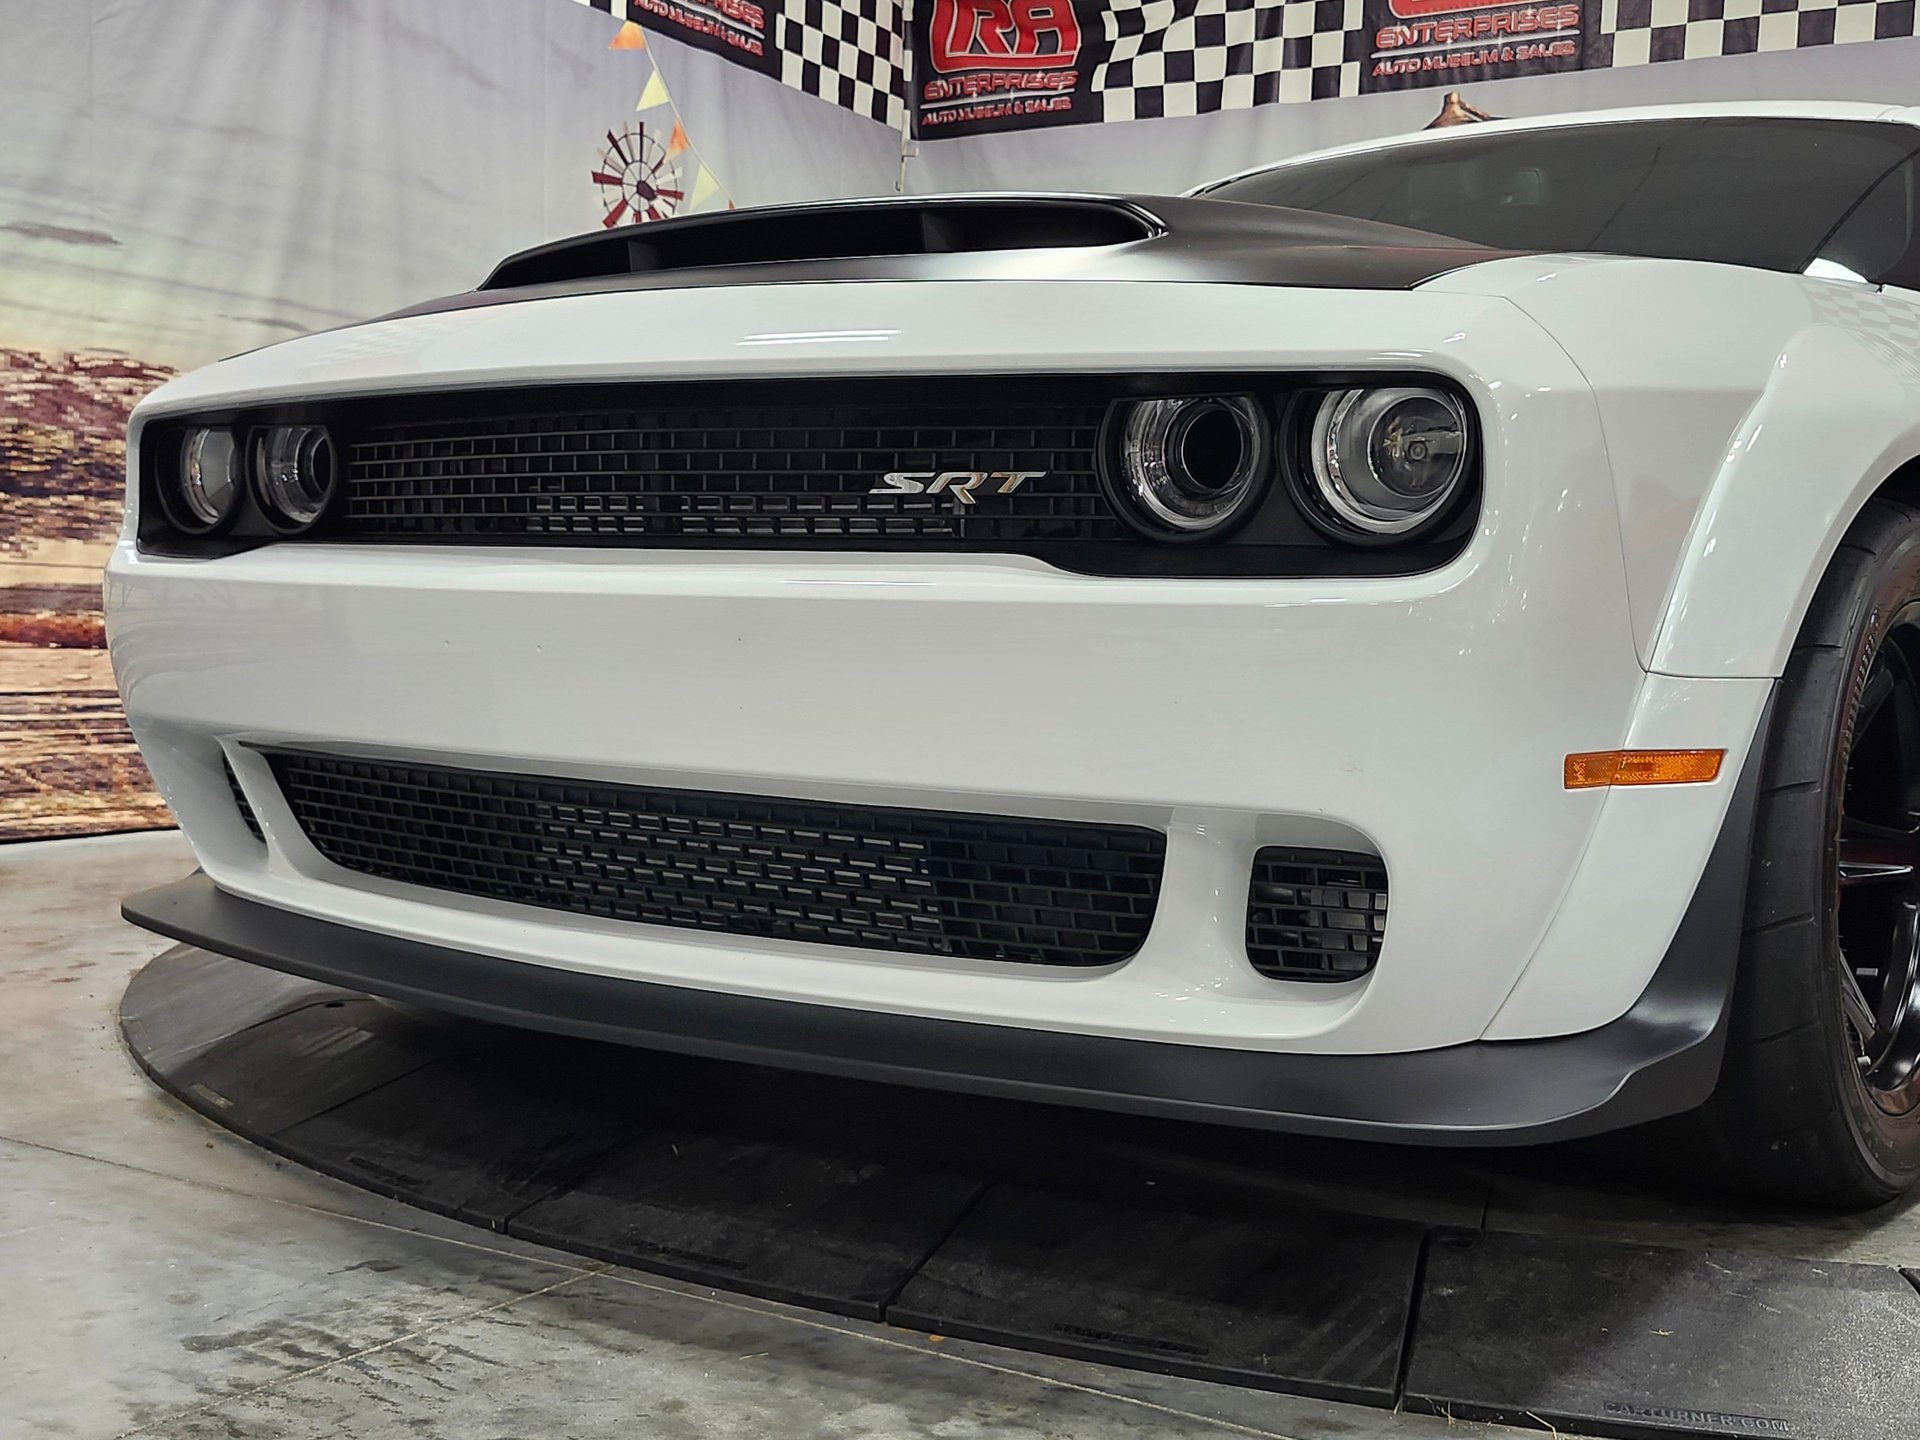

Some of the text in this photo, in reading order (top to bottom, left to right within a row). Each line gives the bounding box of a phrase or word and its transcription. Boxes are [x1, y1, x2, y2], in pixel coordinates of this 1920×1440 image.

[1375, 4, 1580, 49] ENTERPRISES
[1372, 40, 1576, 76] AUTO MUSEUM & SALES
[924, 70, 1079, 100] ENTERPRISES
[921, 97, 1072, 126] AUTO MUSEUM & SALES
[868, 471, 1047, 505] SRT
